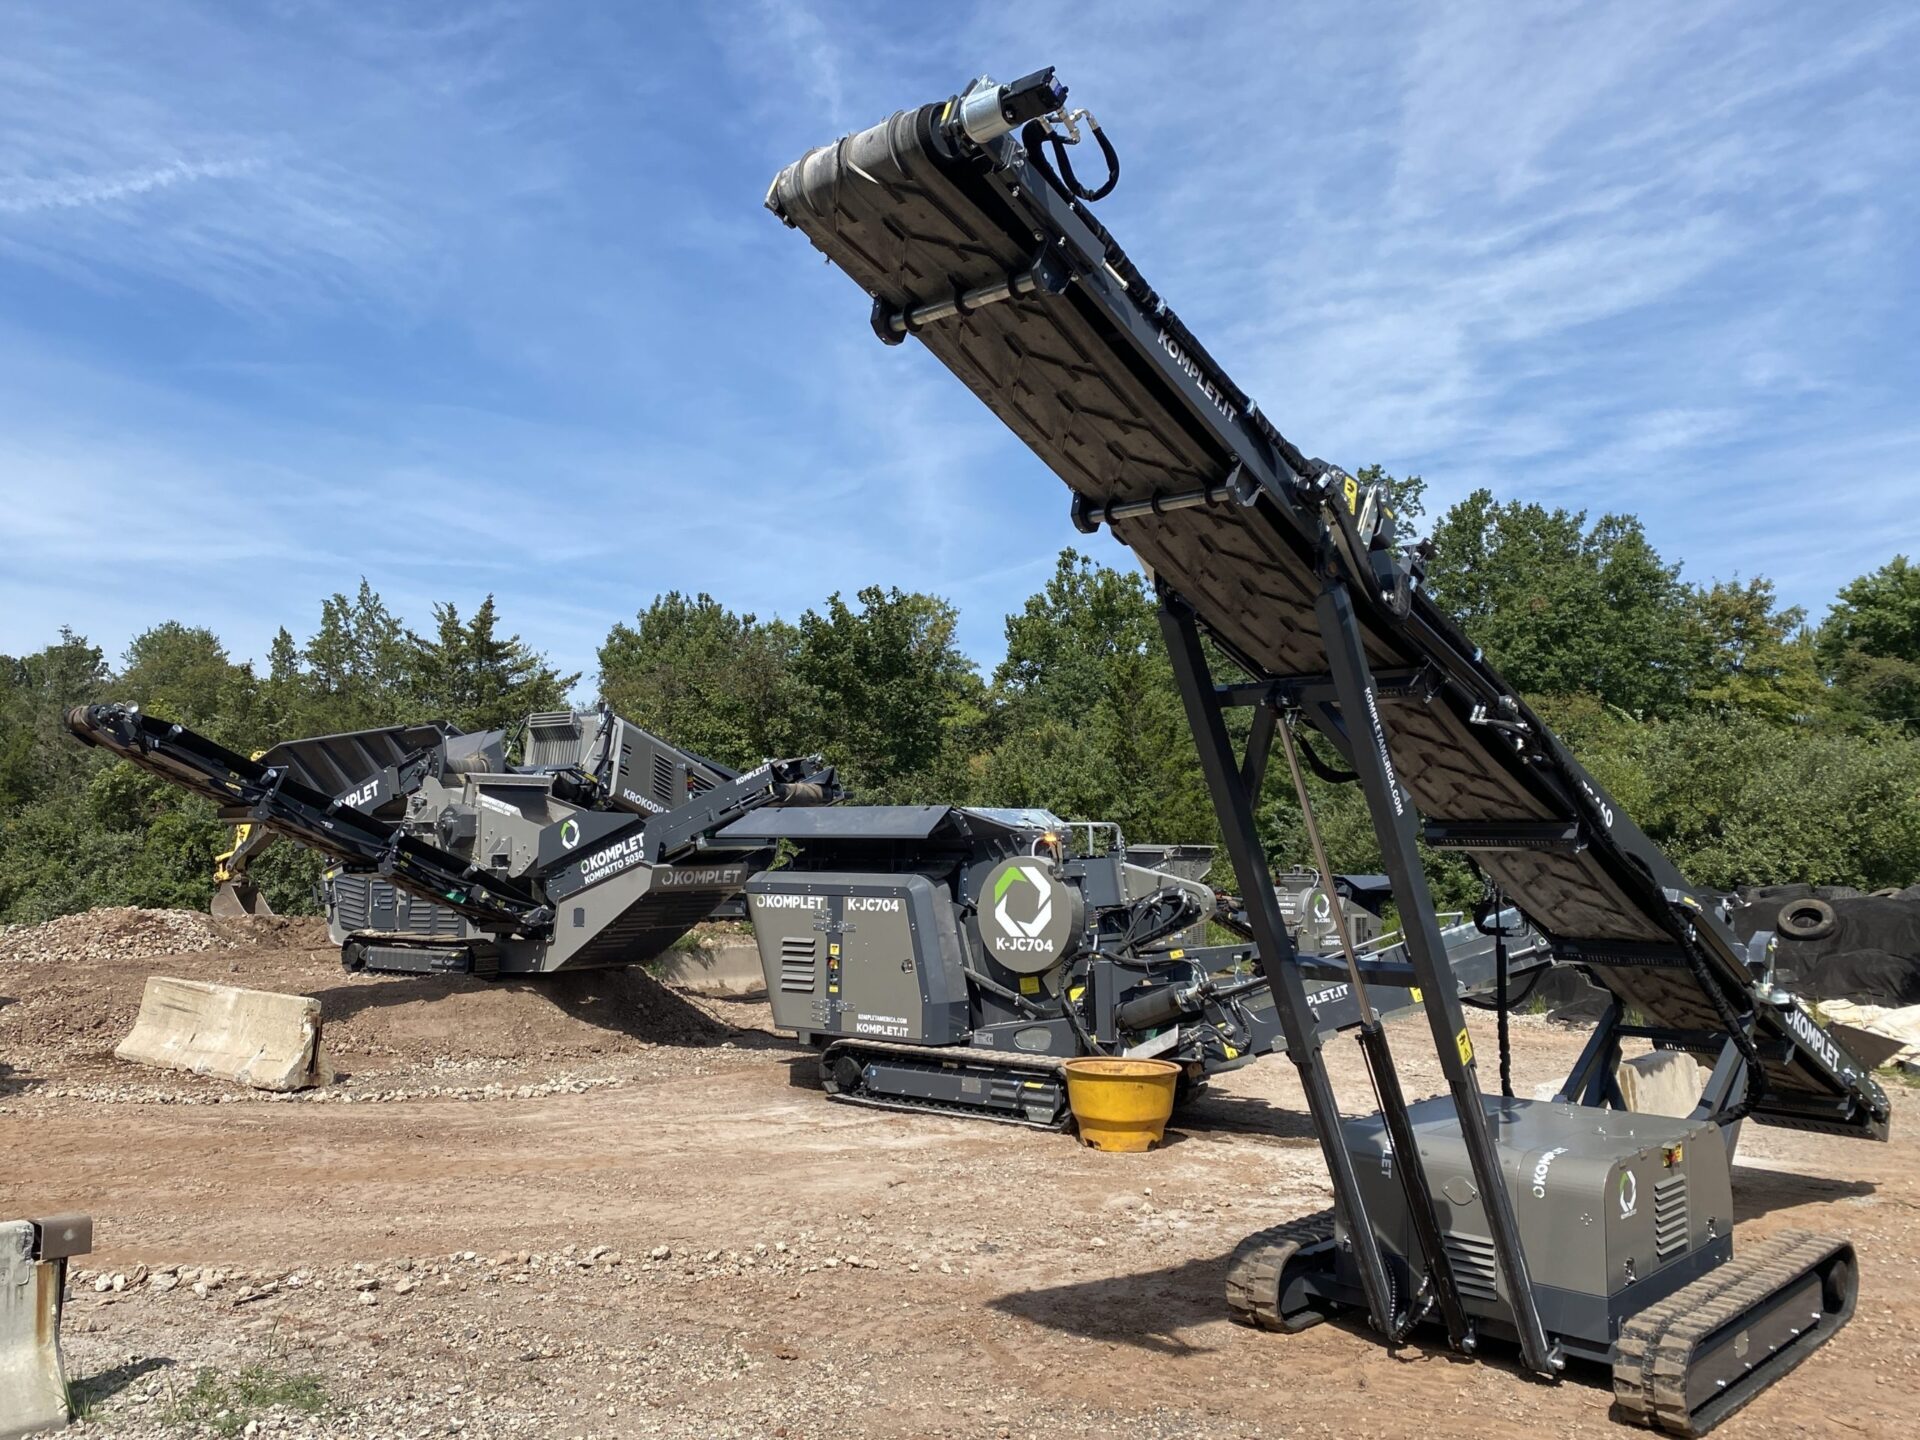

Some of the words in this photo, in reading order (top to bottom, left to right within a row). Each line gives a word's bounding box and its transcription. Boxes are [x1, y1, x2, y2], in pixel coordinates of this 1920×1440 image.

[1157, 328, 1238, 423] KOMPLET.IT
[1364, 687, 1404, 817] KOMPLETAMERICA.COM
[735, 763, 771, 786] KOMPLET.IT
[623, 787, 671, 814] KROKOD
[589, 832, 645, 871] KOMPLET
[584, 861, 624, 885] KOMPATTO
[625, 850, 645, 866] 5030
[673, 869, 742, 885] KOMPLET
[766, 895, 824, 910] KOMPLET
[847, 899, 900, 912] K-JC704
[995, 937, 1054, 953] K-JC704
[1306, 983, 1348, 1007] PLET.IT
[856, 1023, 909, 1037] KOMPLET.IT
[1792, 1009, 1840, 1072] KOMPLET
